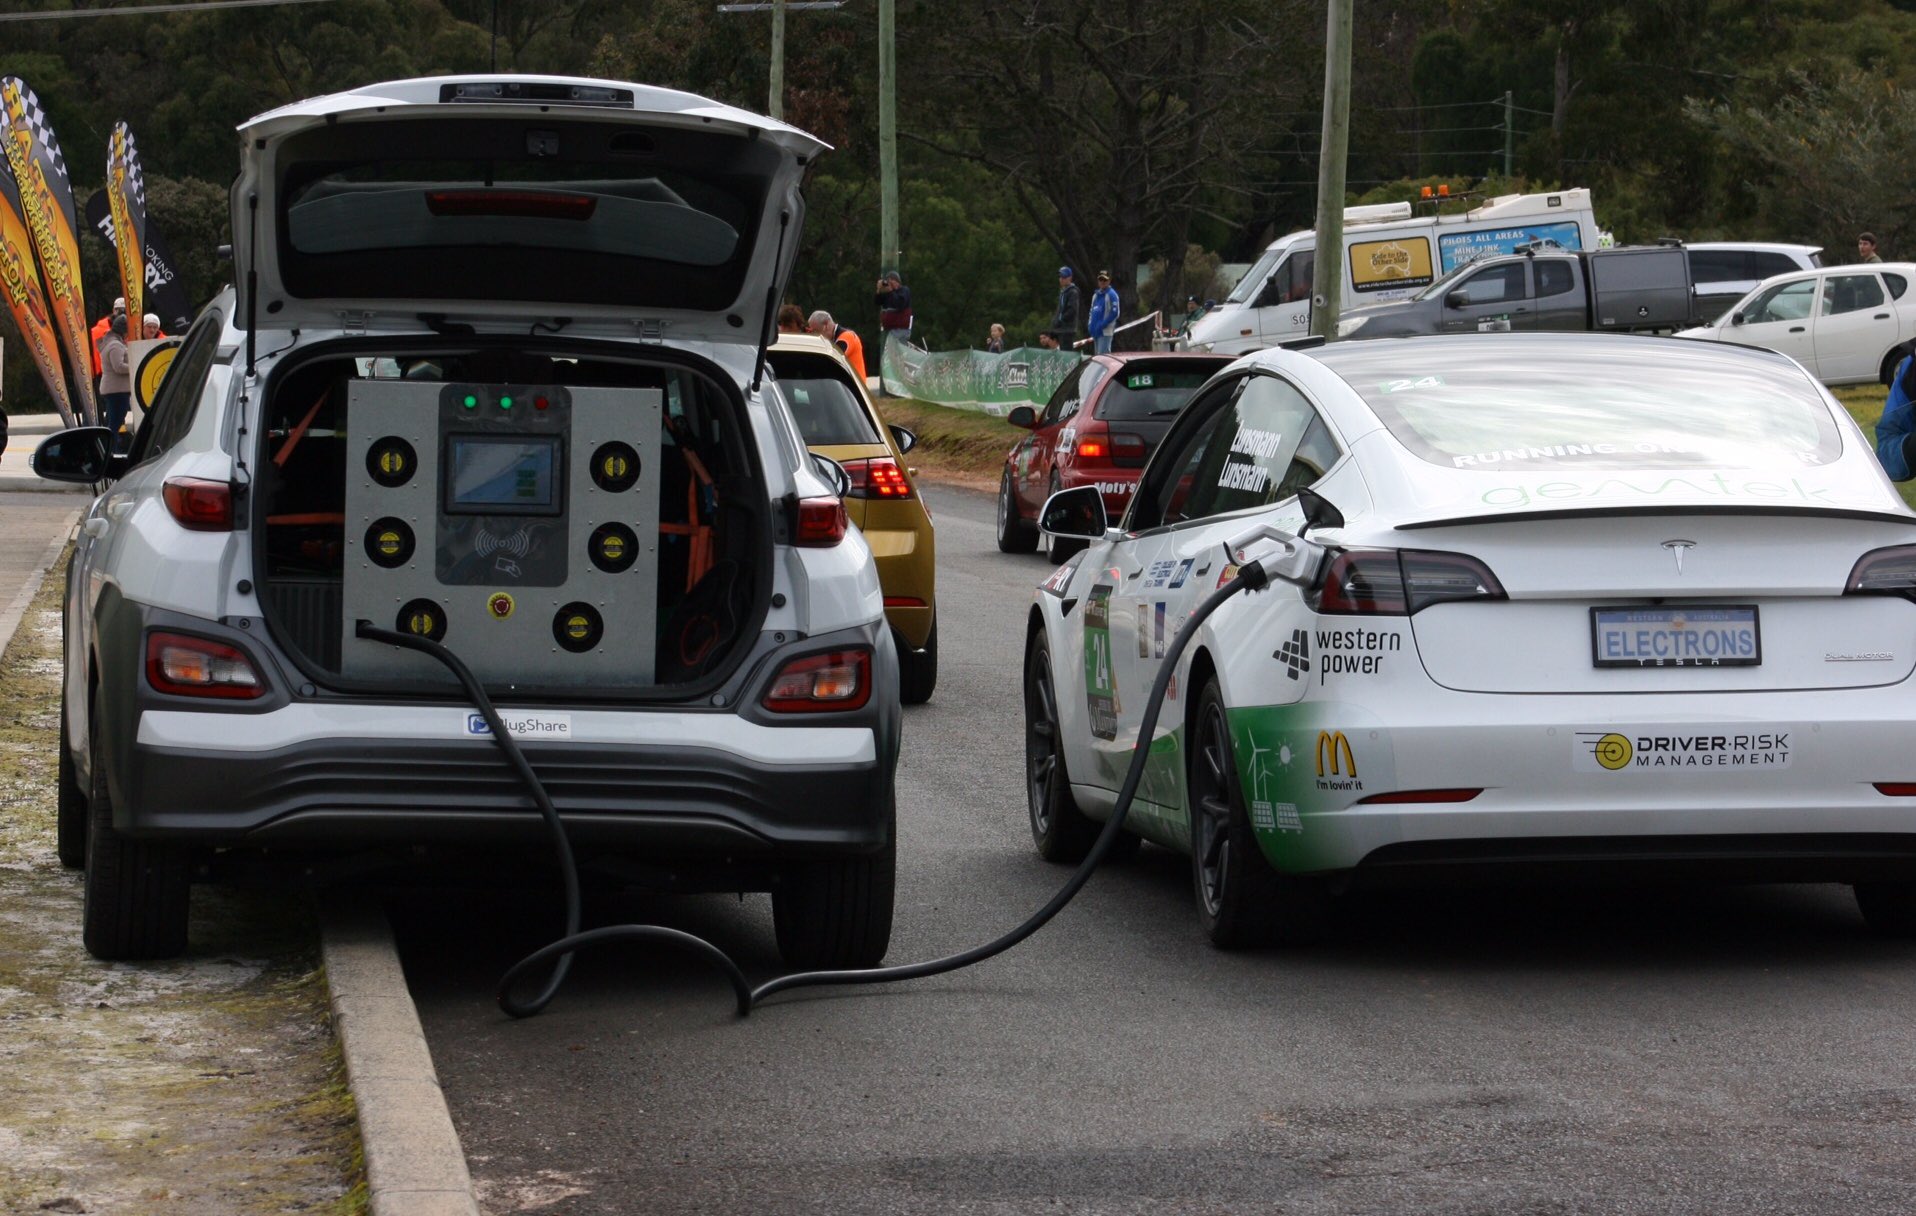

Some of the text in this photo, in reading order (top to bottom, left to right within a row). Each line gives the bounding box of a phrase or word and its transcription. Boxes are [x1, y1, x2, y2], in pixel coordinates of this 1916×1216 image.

[1443, 230, 1525, 246] PILOTS ALL AREAS
[1133, 374, 1152, 385] 18
[1388, 376, 1441, 391] 24
[1452, 442, 1618, 468] RUNNING
[1094, 480, 1137, 495] Moty's
[1316, 628, 1400, 651] western
[1605, 629, 1753, 657] ELECTRONS
[1093, 633, 1109, 690] 24
[1638, 658, 1720, 666] TESLA
[1321, 654, 1383, 686] power
[504, 718, 568, 734] lugShare
[1636, 751, 1790, 767] MANAGEMENT
[1354, 781, 1364, 791] it
